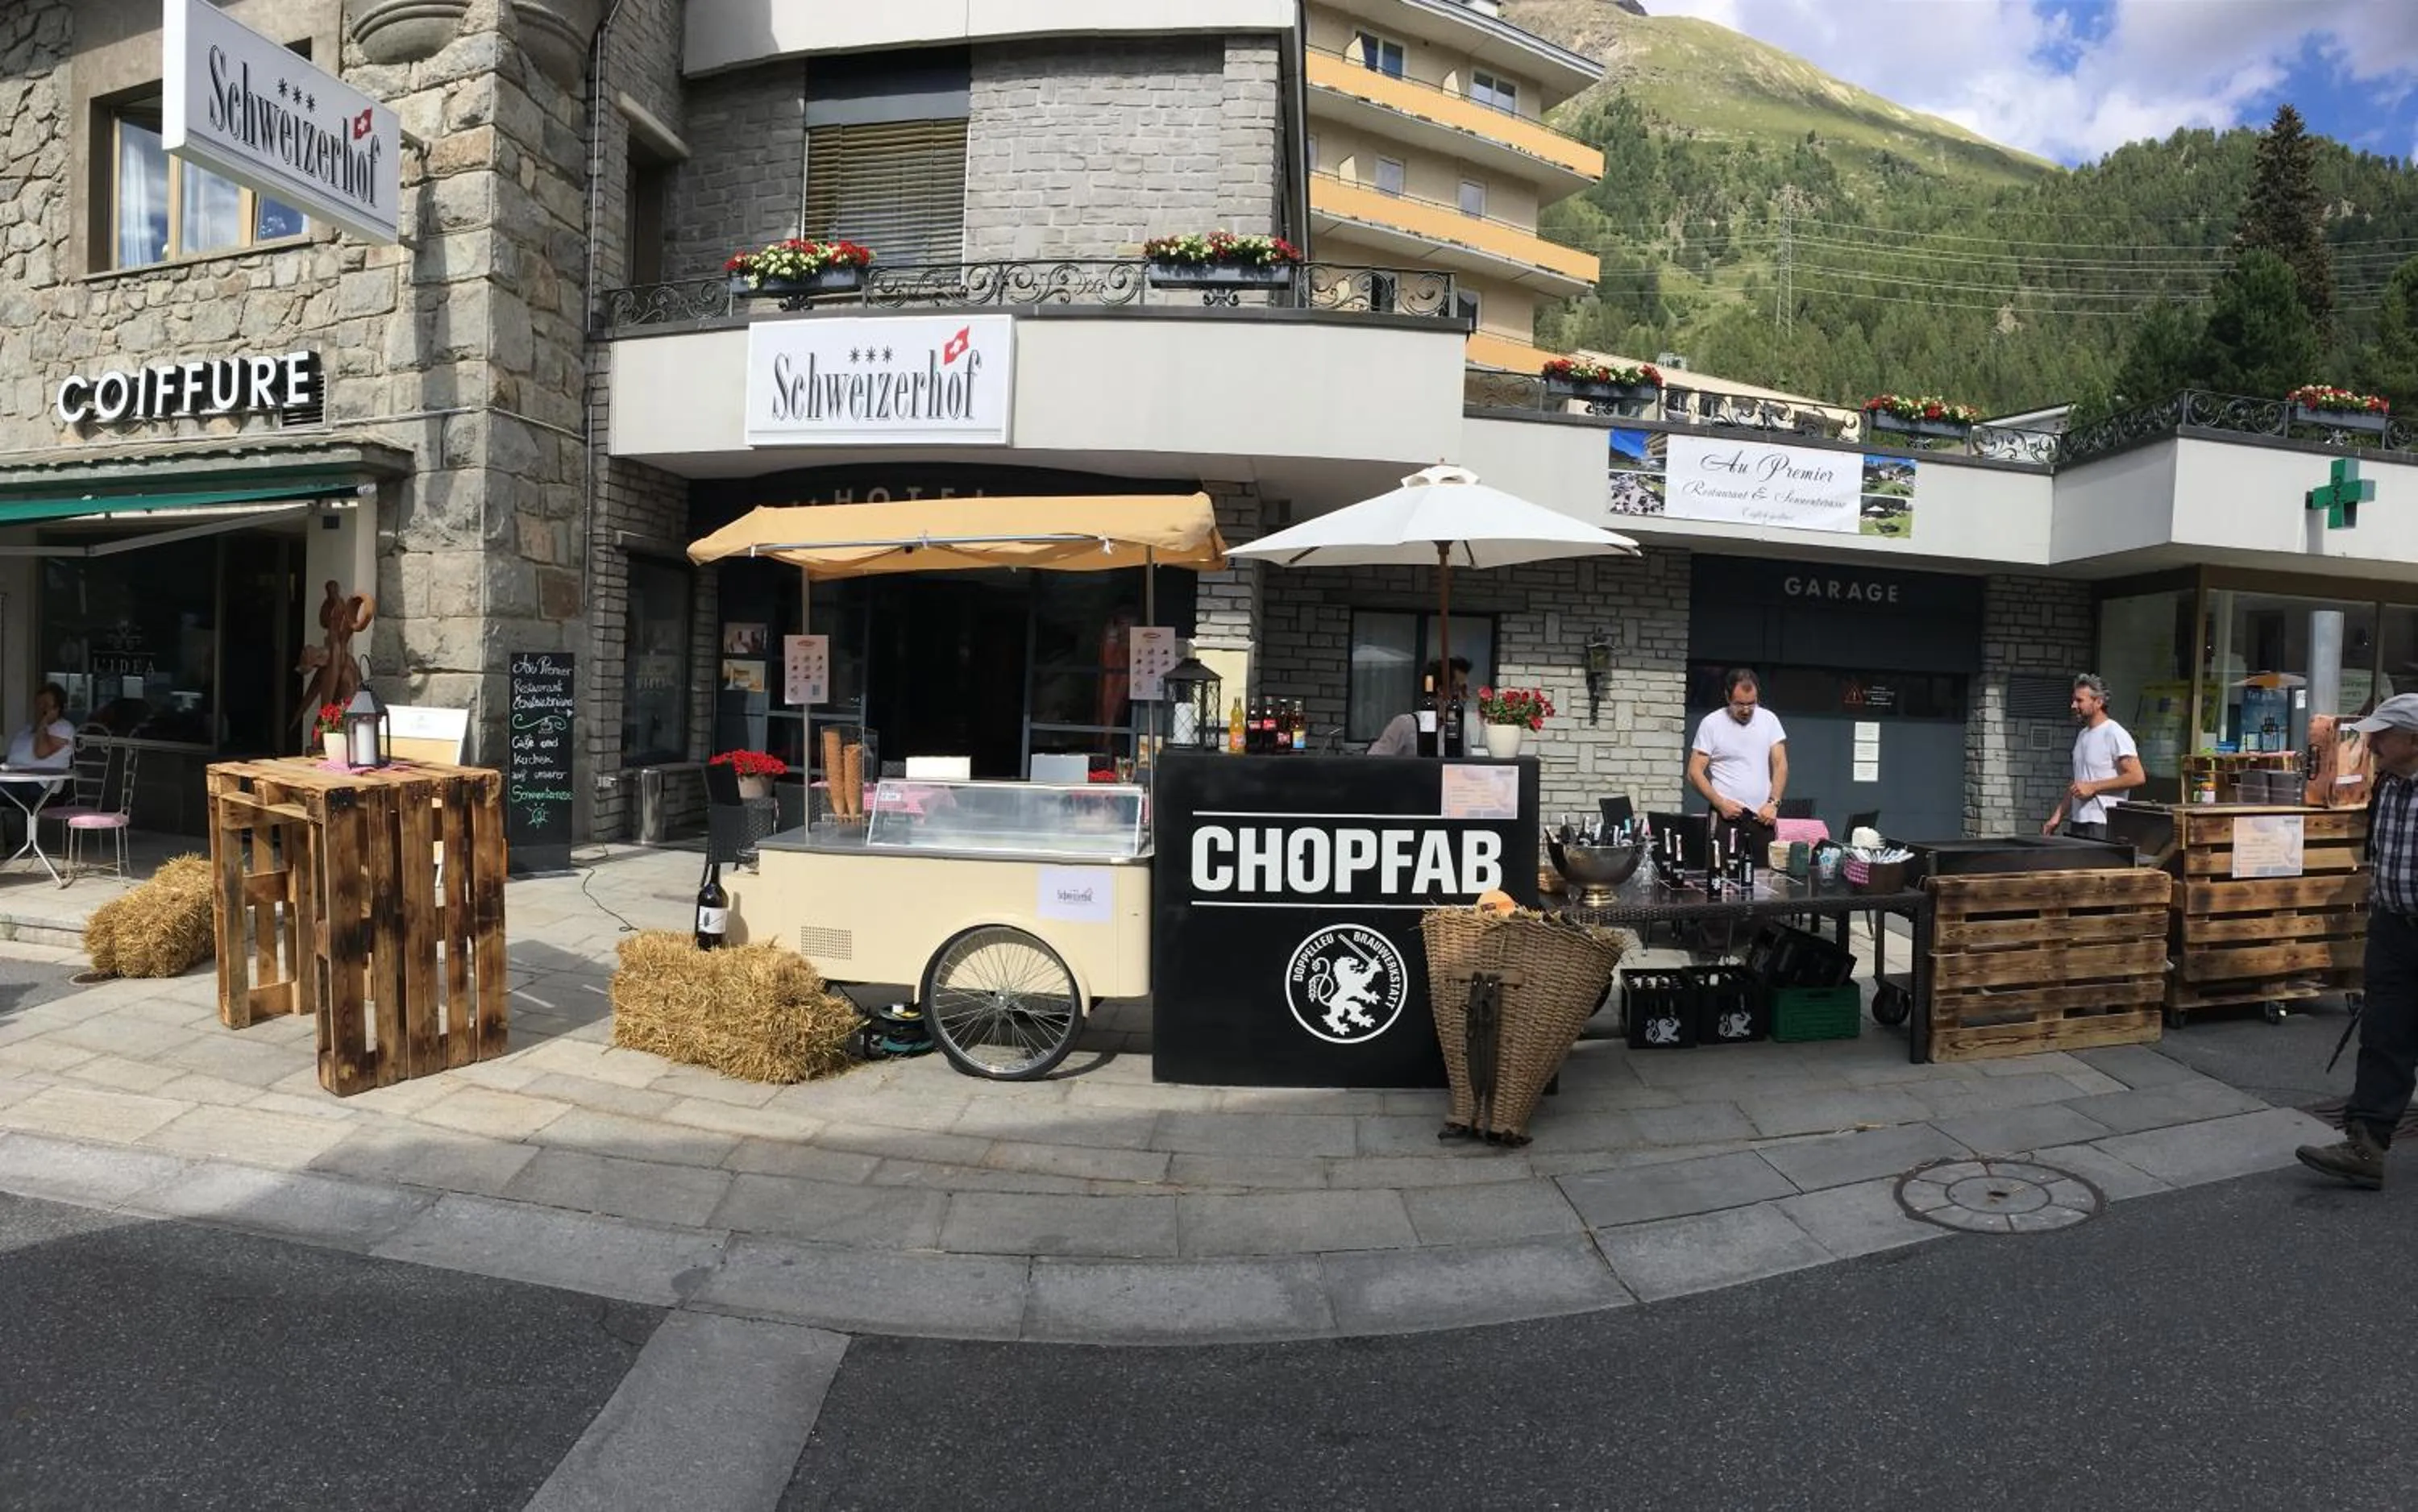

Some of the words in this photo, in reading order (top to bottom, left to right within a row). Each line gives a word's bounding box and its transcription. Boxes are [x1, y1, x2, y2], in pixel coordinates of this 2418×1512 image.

[208, 44, 381, 209] Schweizerhof
[57, 350, 314, 423] COIFFURE
[772, 348, 983, 422] Schweizerhof
[1700, 450, 1748, 474] Au
[1756, 452, 1835, 484] Premier
[1784, 576, 1901, 604] GARAGE
[1190, 825, 1504, 895] CHOPFAB
[1292, 933, 1335, 982] DOPPELLEU
[1353, 931, 1401, 1011] BRAUWERKSTATT
